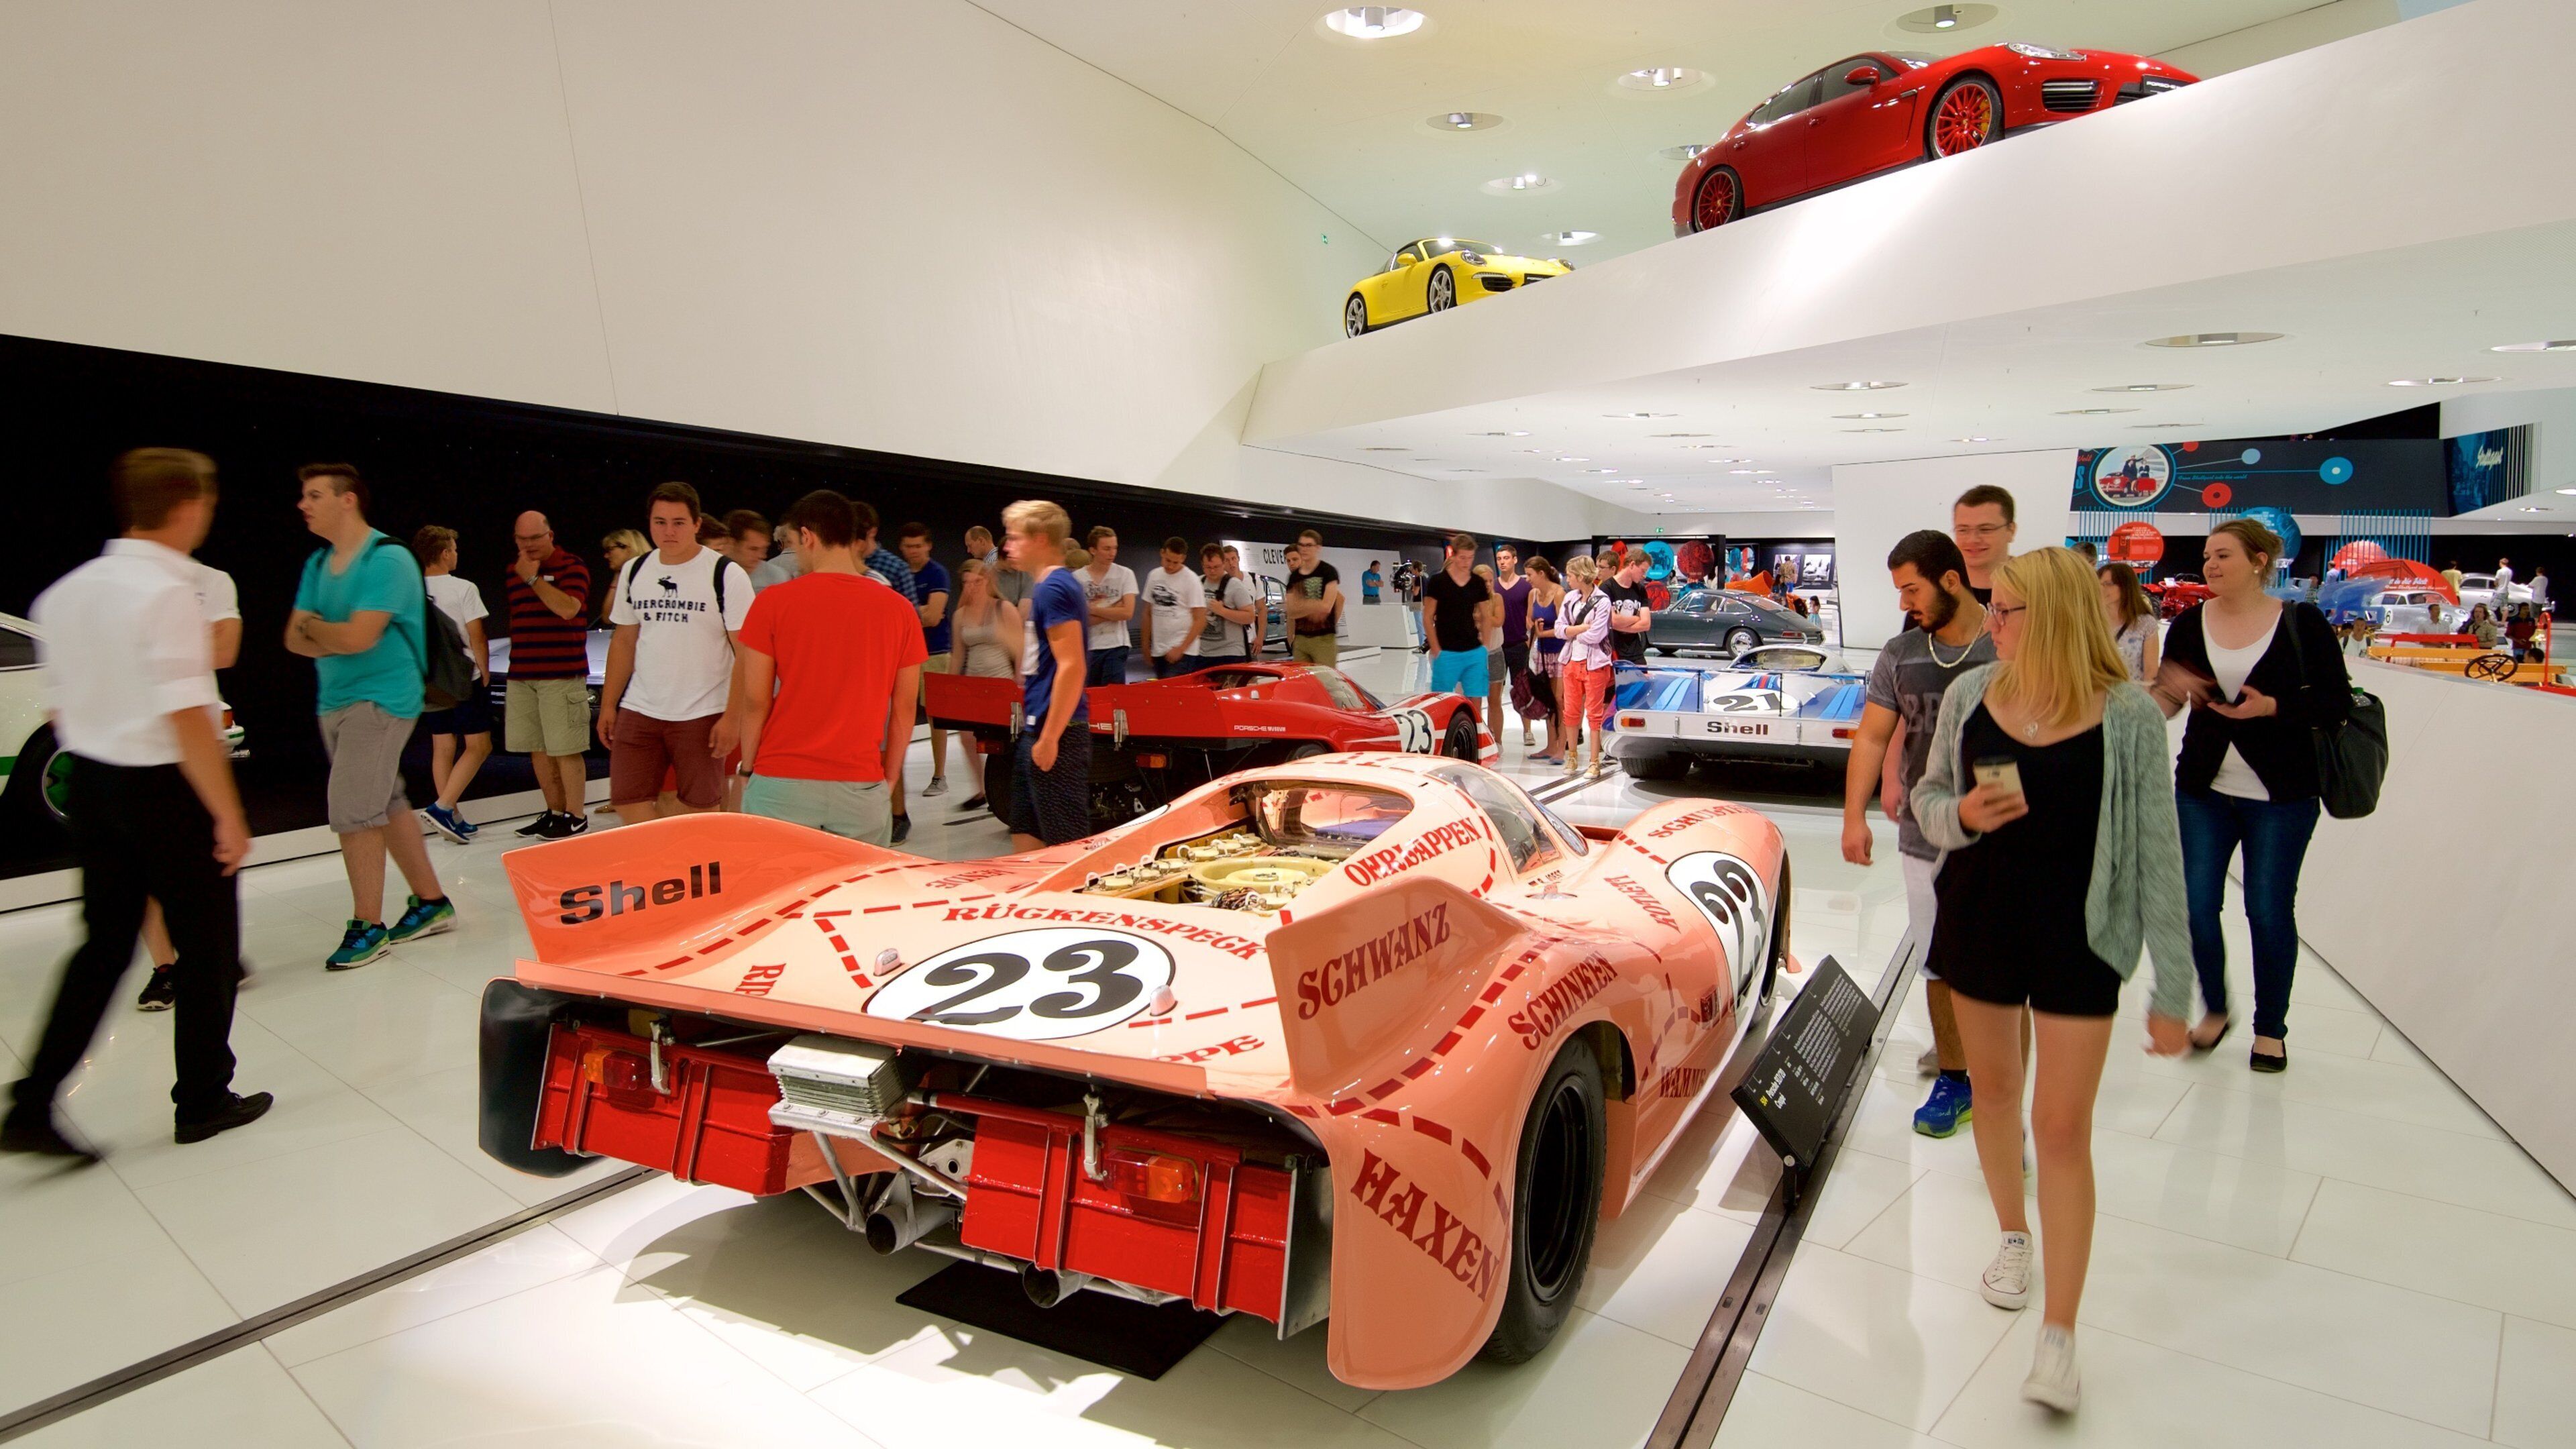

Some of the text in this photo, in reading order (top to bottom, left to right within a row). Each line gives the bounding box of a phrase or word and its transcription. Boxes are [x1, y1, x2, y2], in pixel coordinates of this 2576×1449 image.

[643, 612, 688, 623] & FITCH
[1393, 710, 1432, 755] 23
[1707, 721, 1768, 735] Shell
[1713, 692, 1792, 712] 21
[559, 861, 722, 925] Shell
[942, 902, 1267, 961] RÜCKENSPECK
[1297, 901, 1450, 1020] SCHWANZ
[906, 939, 1144, 1026] 23
[1508, 950, 1618, 1051] SCHINKEN
[1350, 1147, 1501, 1303] HAXEN
